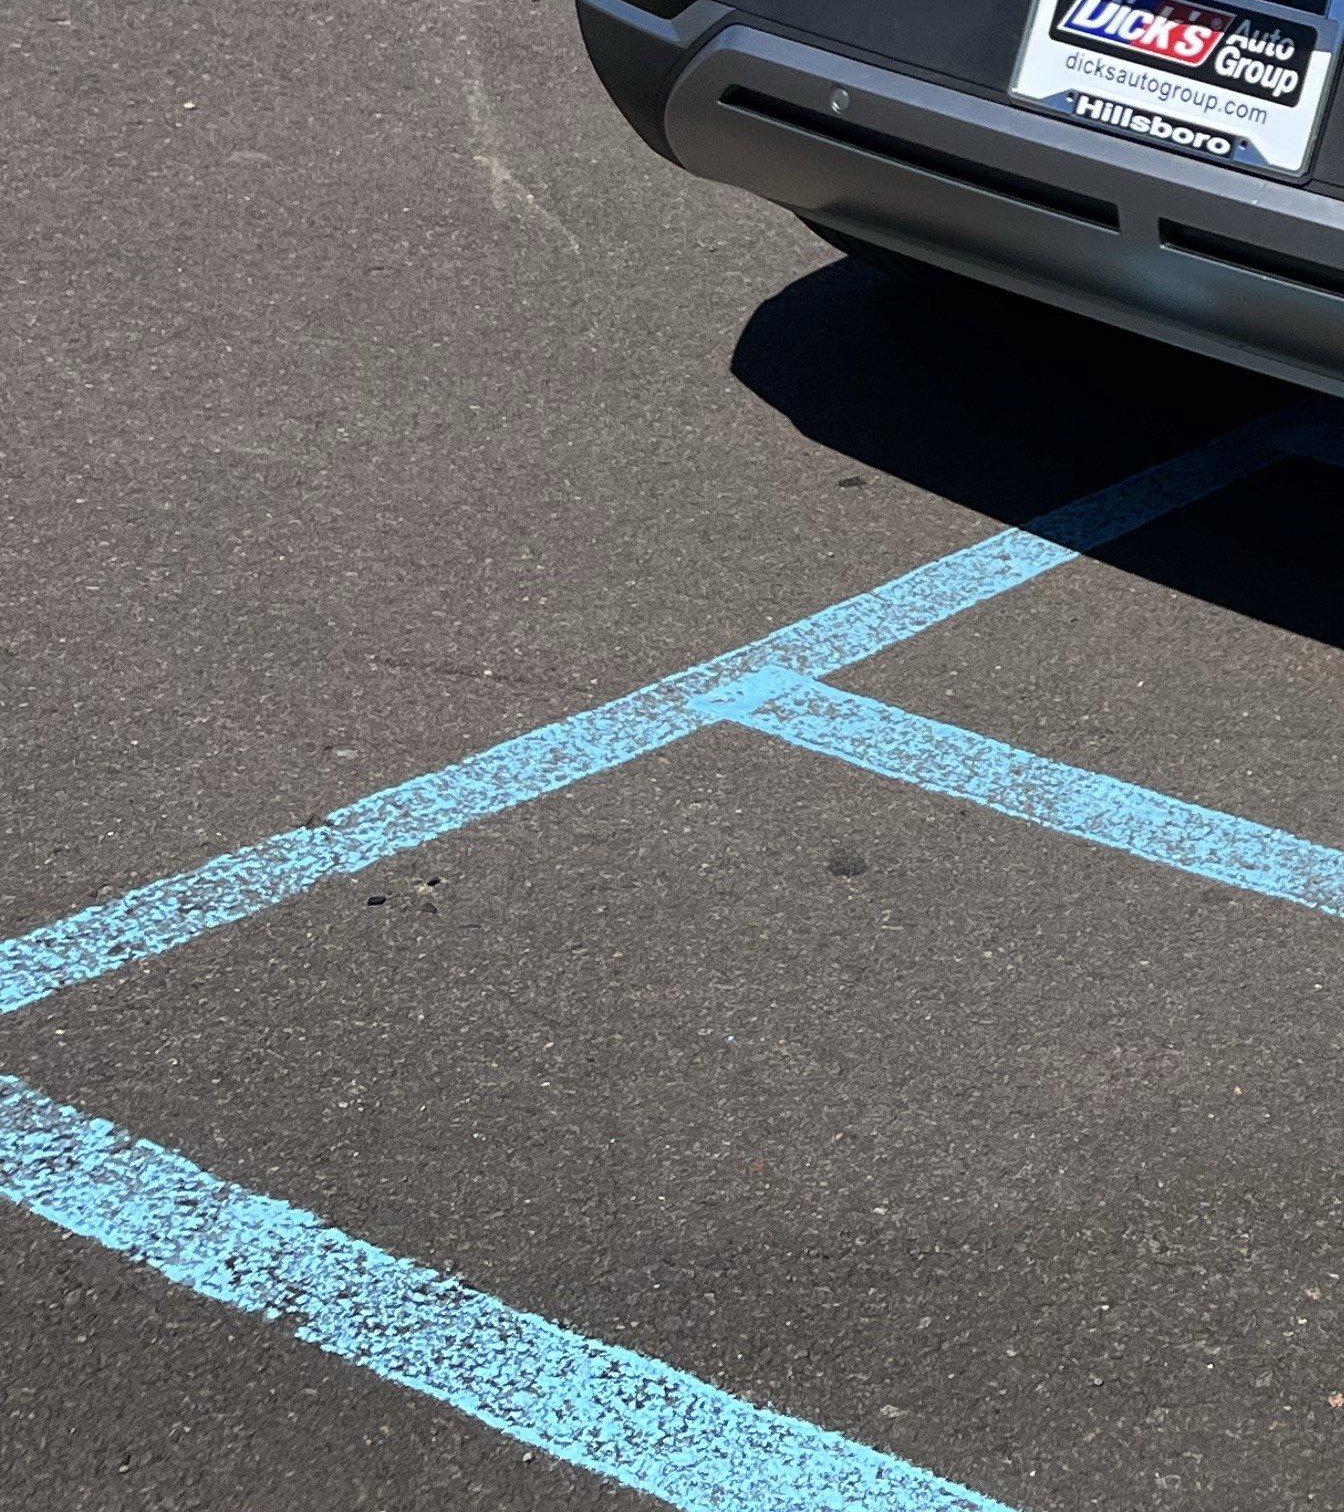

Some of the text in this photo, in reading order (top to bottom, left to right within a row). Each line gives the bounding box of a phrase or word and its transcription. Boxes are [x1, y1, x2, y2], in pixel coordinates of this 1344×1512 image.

[1226, 18, 1296, 61] Auto
[1065, 51, 1268, 125] dicksautogroup.com
[1214, 46, 1300, 98] Group
[1075, 95, 1231, 155] Hillsboro
